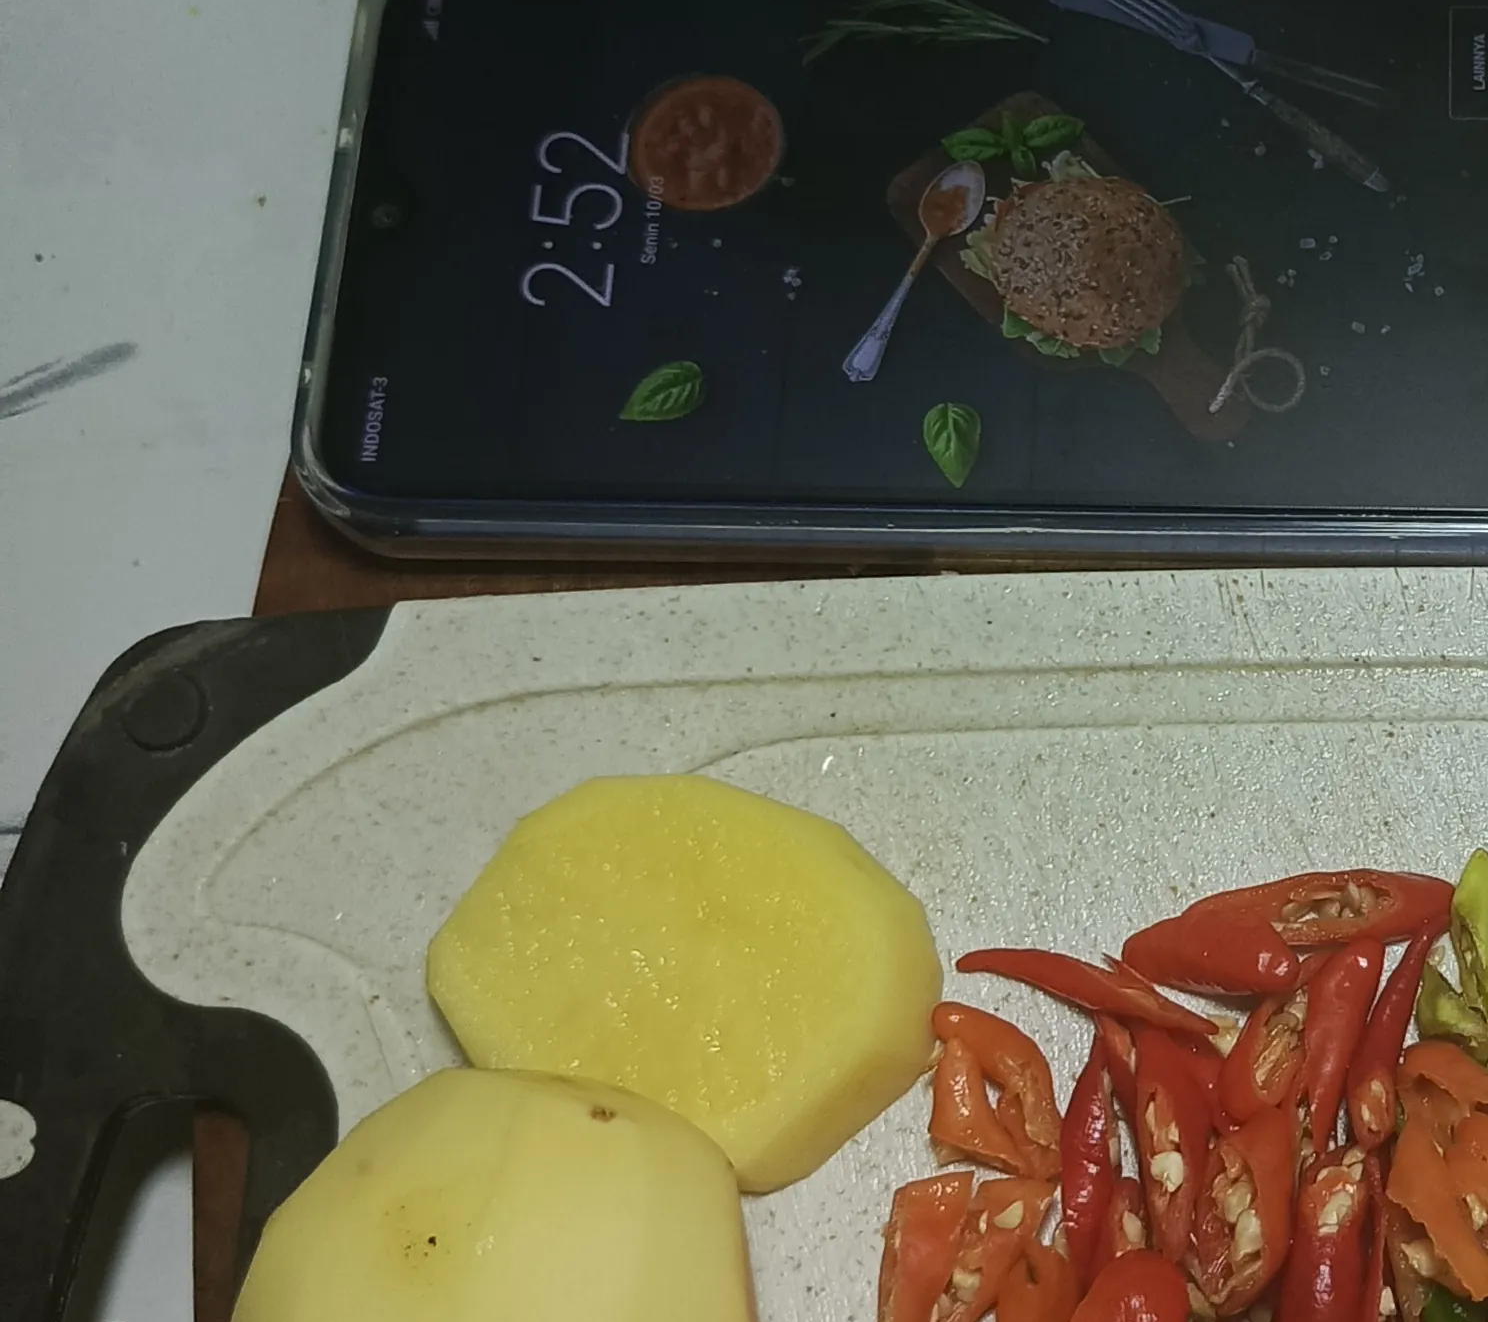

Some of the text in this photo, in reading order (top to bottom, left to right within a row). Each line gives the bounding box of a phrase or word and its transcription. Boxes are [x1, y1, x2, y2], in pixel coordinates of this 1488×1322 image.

[1472, 32, 1486, 91] LAINNYA
[520, 130, 630, 306] 2:52
[640, 175, 665, 264] Senin 10/03
[360, 375, 388, 461] INDOSAT-3
